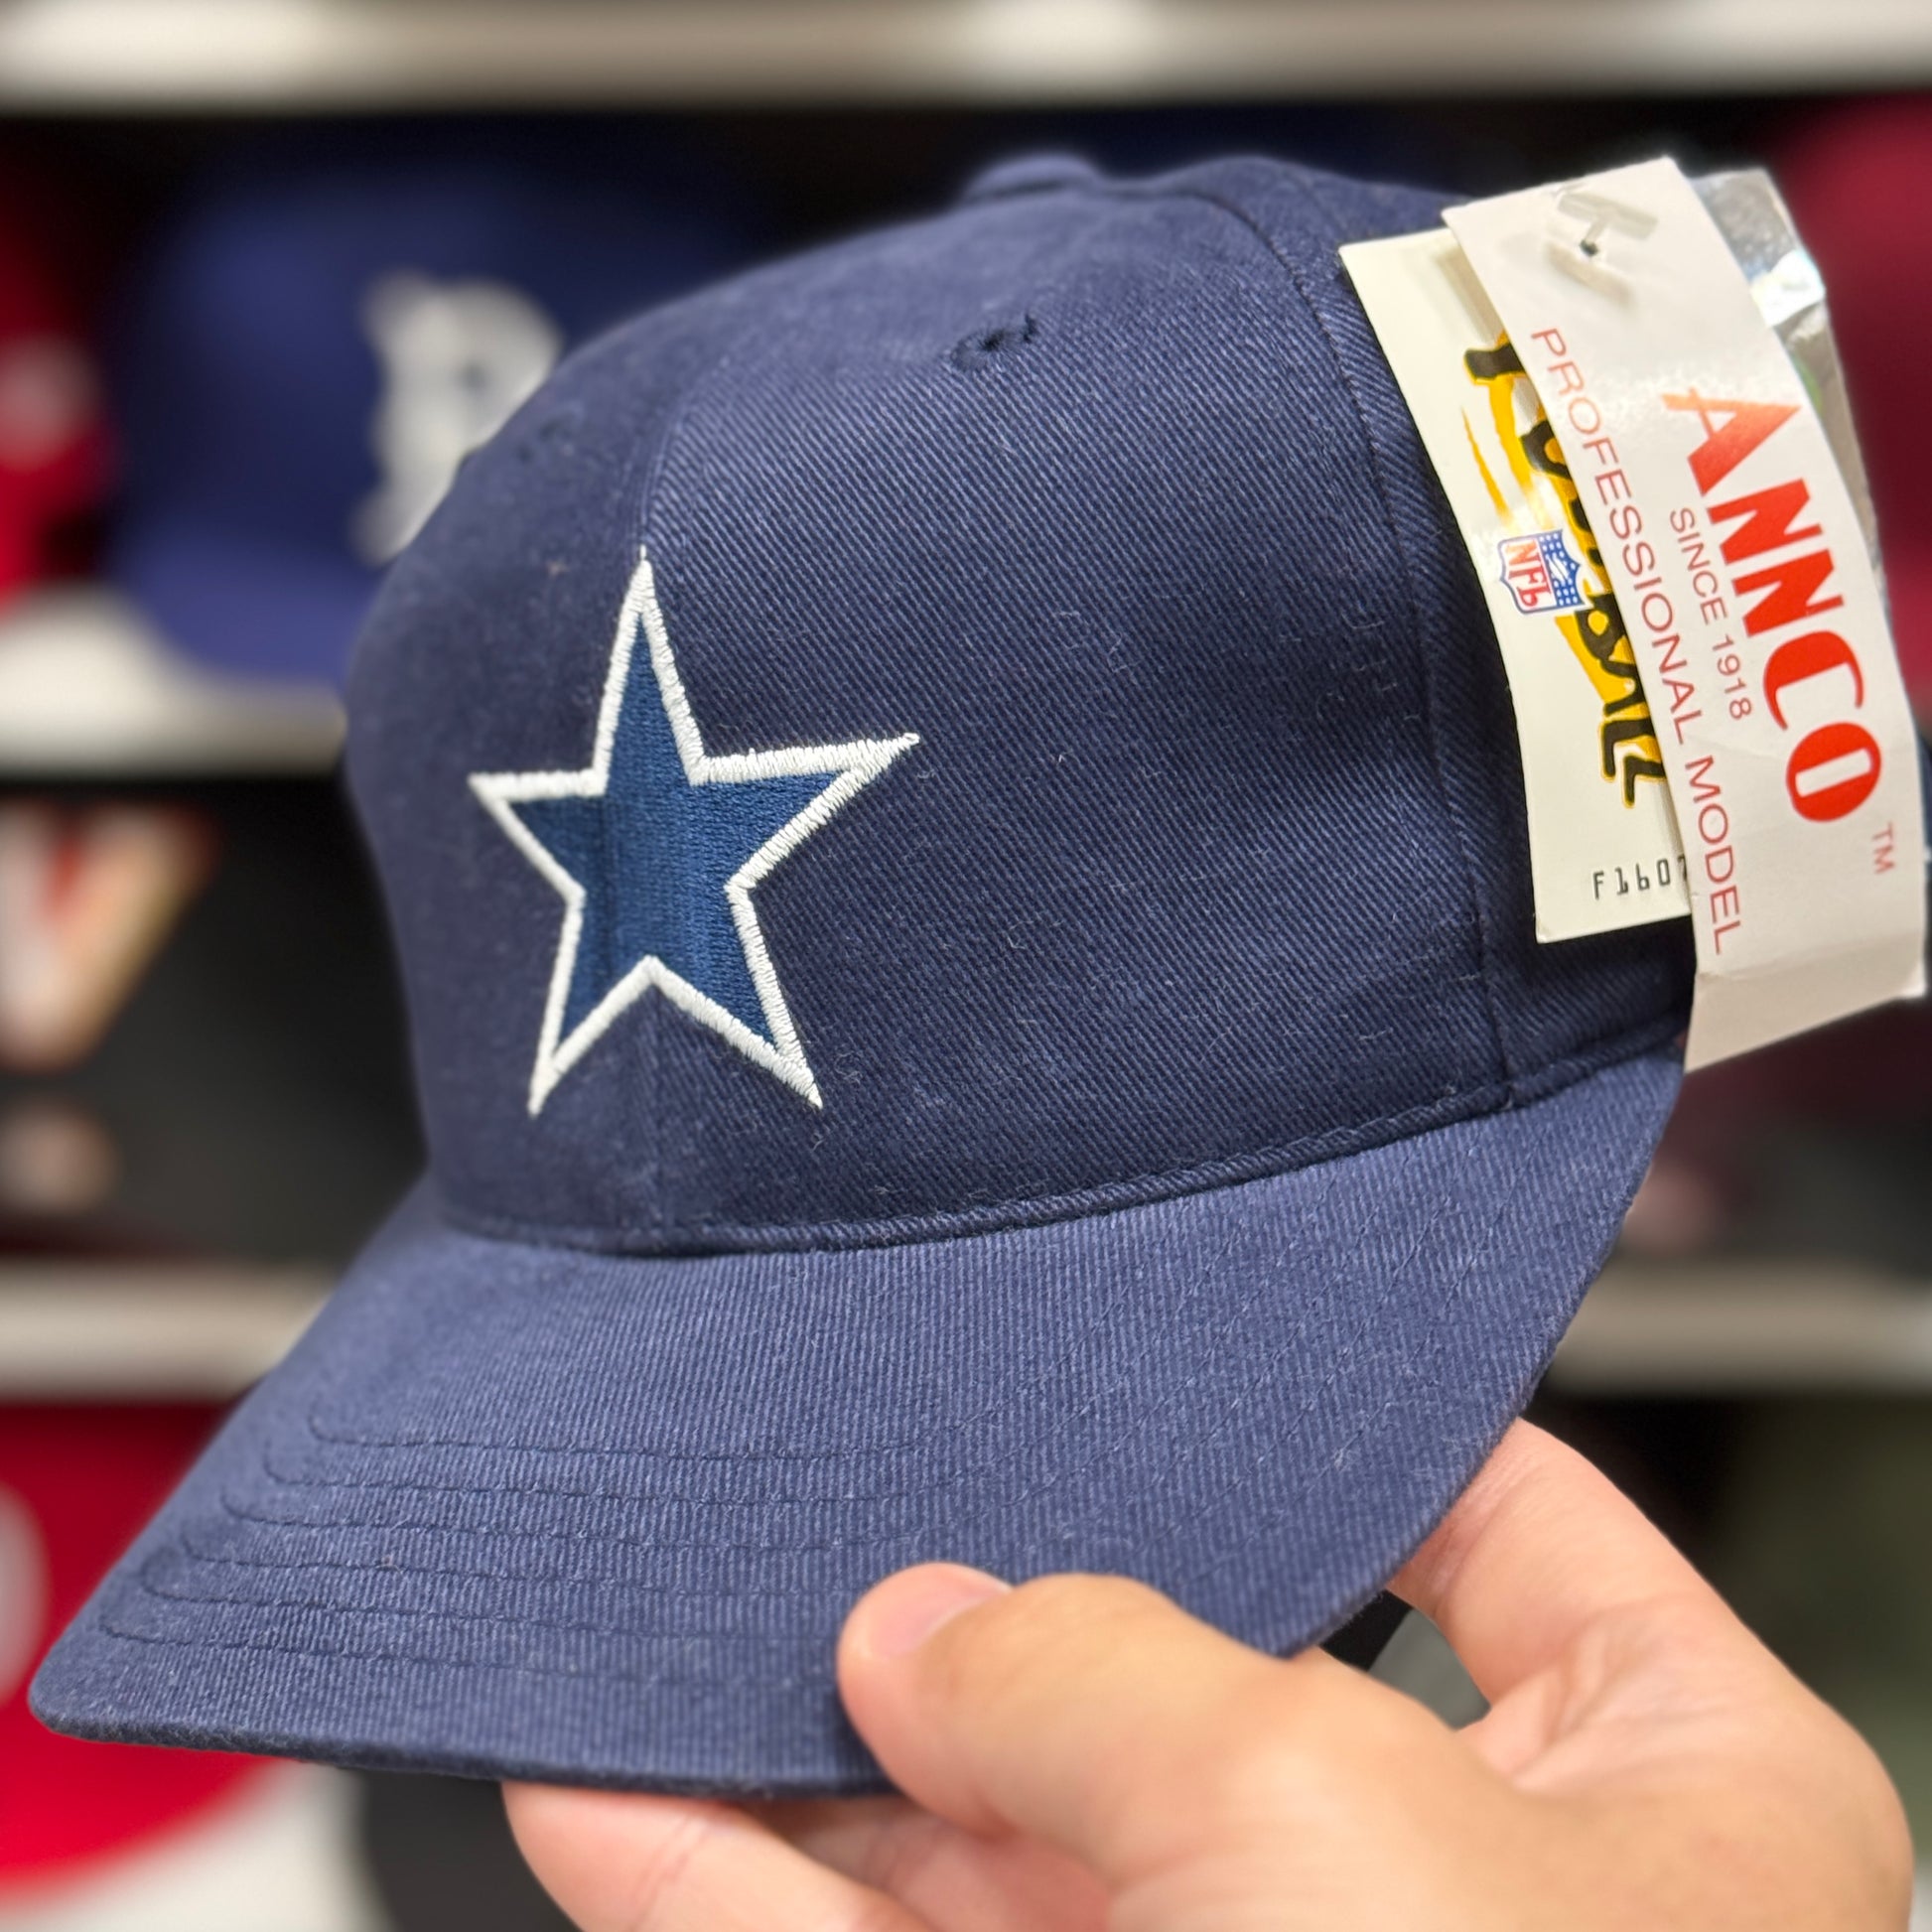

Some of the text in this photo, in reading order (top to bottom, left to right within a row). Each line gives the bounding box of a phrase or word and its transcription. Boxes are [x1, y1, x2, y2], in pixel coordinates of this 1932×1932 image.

[1504, 539, 1552, 608] NFL
[1531, 329, 1741, 954] PROFESSIONAL MODEL
[1662, 389, 1881, 823] ANNCO
[1671, 509, 1752, 720] SINCE 1918
